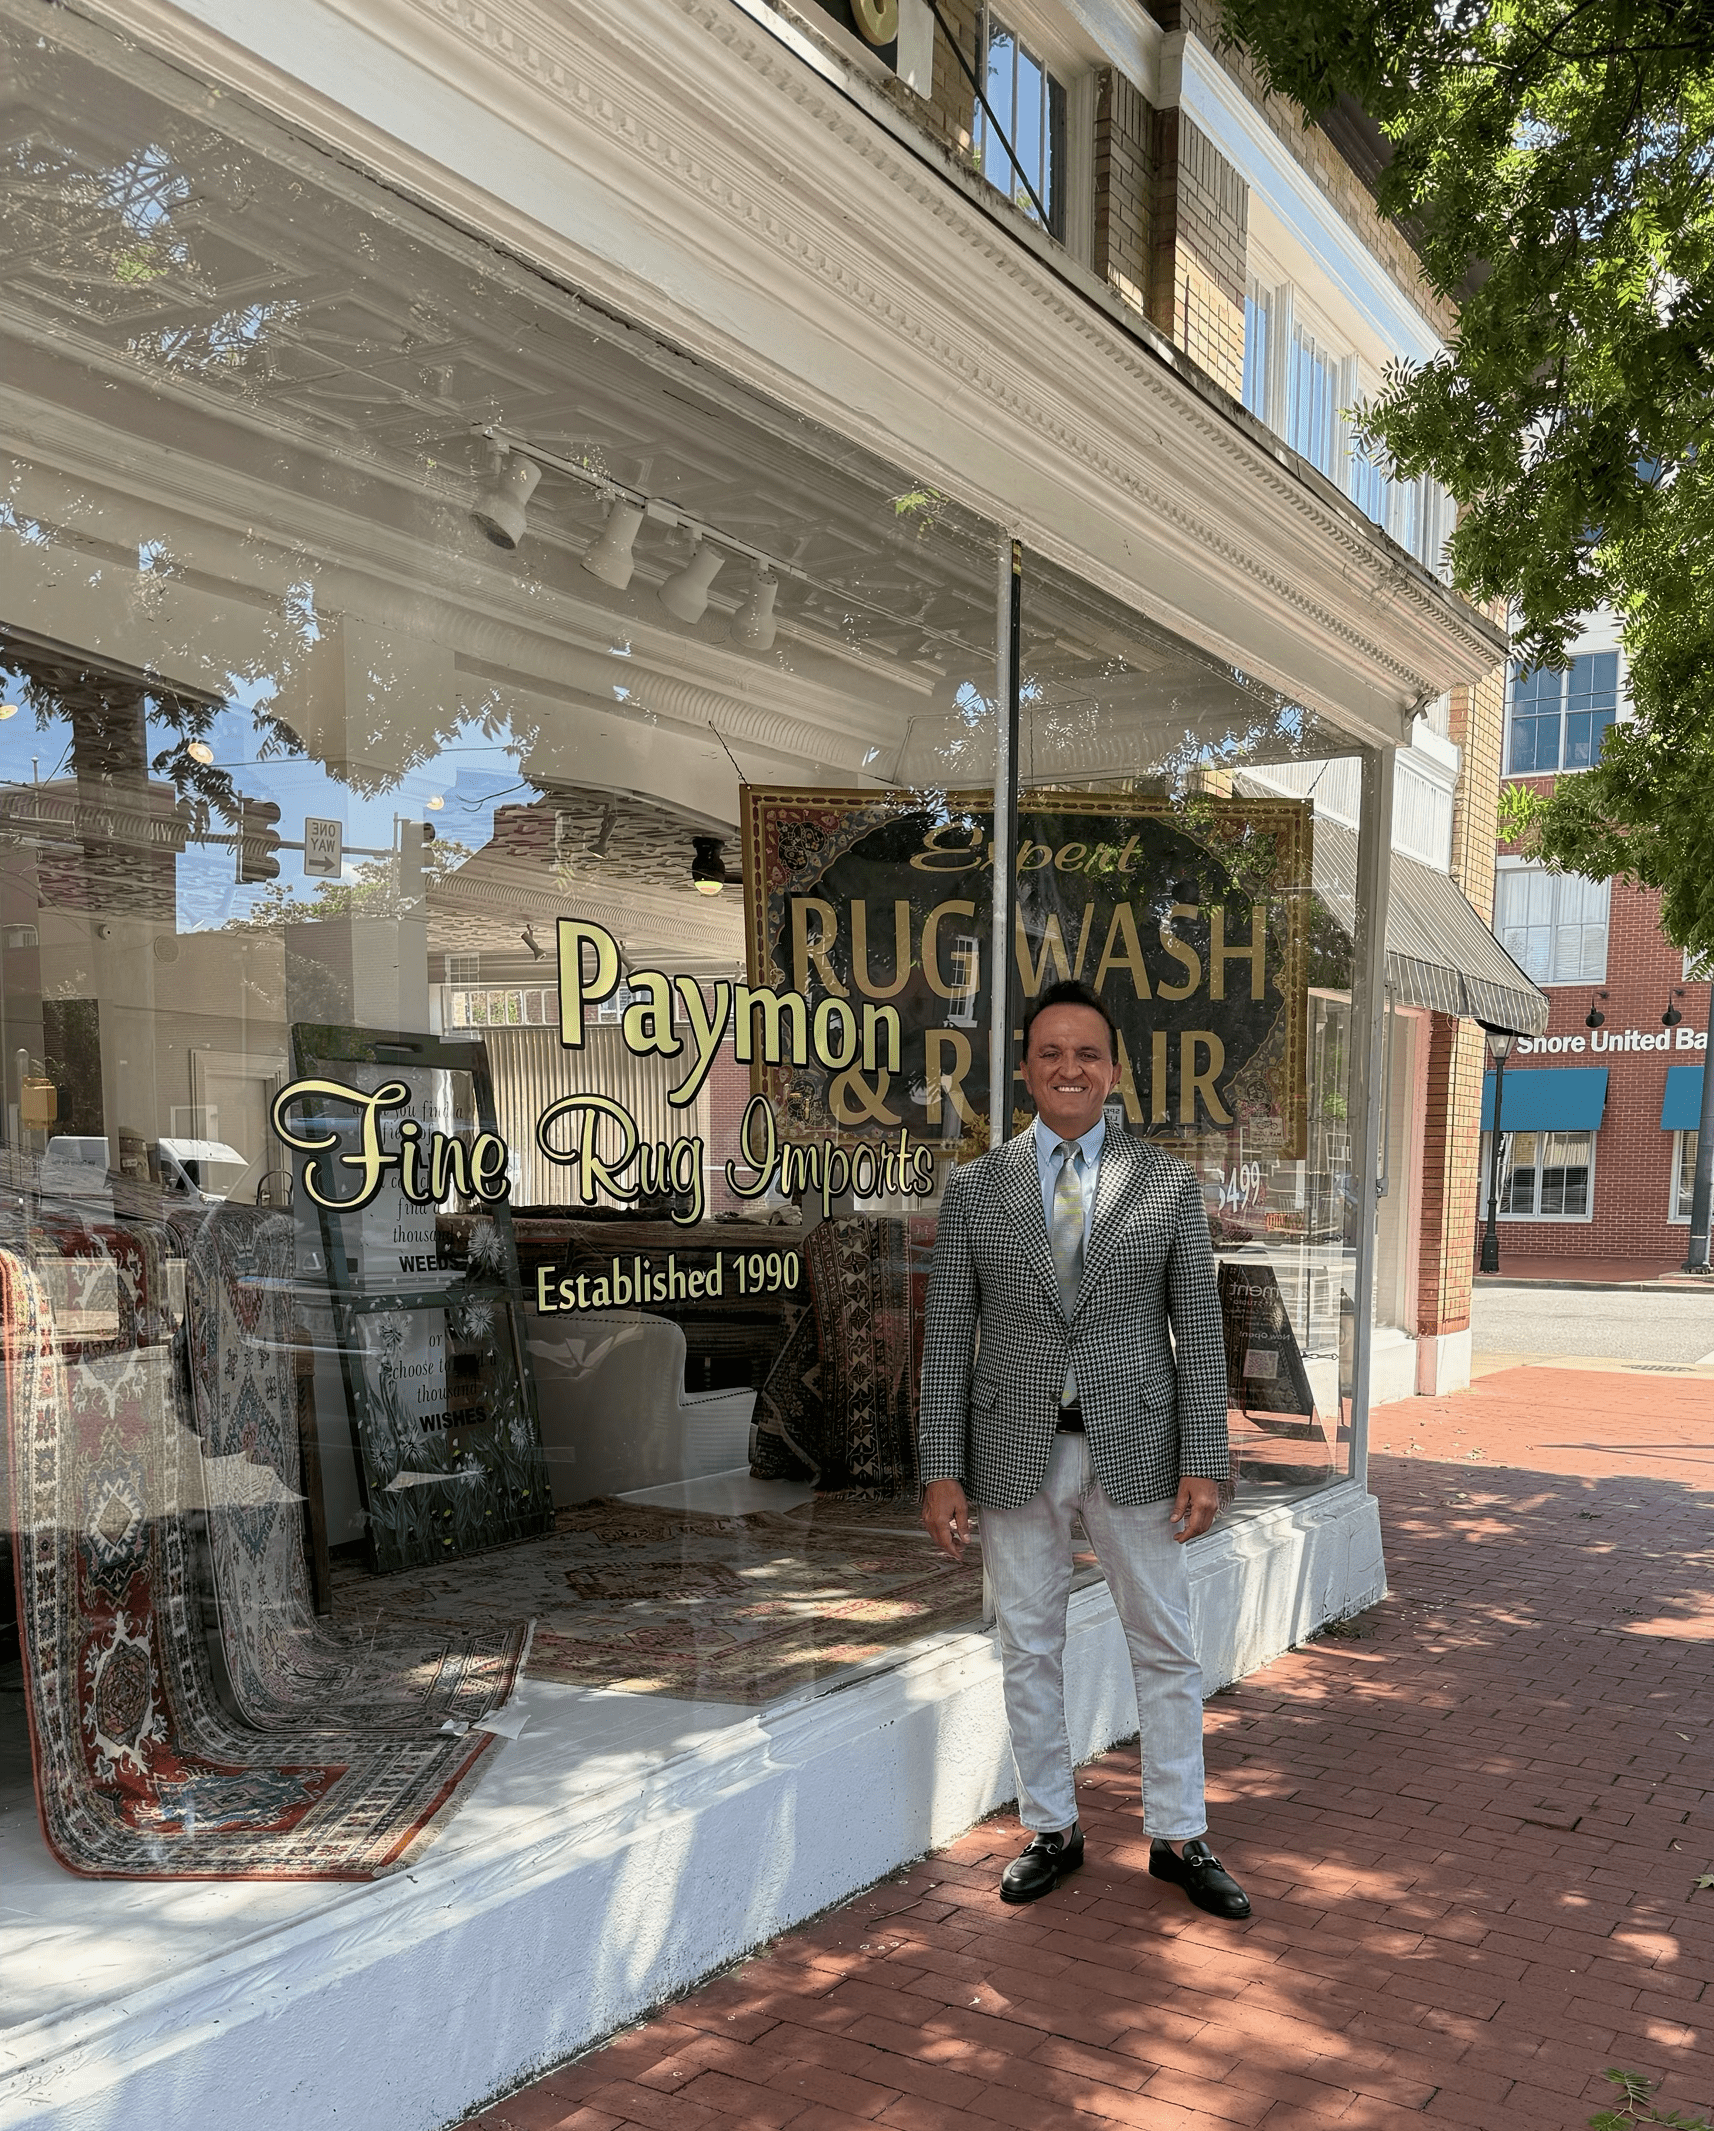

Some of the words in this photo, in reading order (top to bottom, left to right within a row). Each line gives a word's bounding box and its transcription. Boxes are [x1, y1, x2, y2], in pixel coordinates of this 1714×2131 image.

[790, 897, 977, 998] RUG
[1013, 900, 1267, 1001] WASH
[556, 916, 901, 1109] Paymon
[1590, 1029, 1671, 1052] United
[1675, 1028, 1708, 1050] Ba
[828, 1029, 902, 1126] &
[925, 1028, 1234, 1125] RAIR
[455, 1107, 463, 1118] a
[271, 1076, 512, 1213] Fine
[536, 1093, 704, 1227] Rug
[726, 1093, 935, 1222] Imports
[393, 1224, 455, 1243] thousand
[399, 1254, 460, 1272] WEEDS
[536, 1251, 723, 1314] Established
[731, 1248, 800, 1295] 1990
[429, 1334, 442, 1347] or
[392, 1360, 434, 1380] choose
[417, 1379, 477, 1404] thousand
[419, 1406, 487, 1432] WISHES
